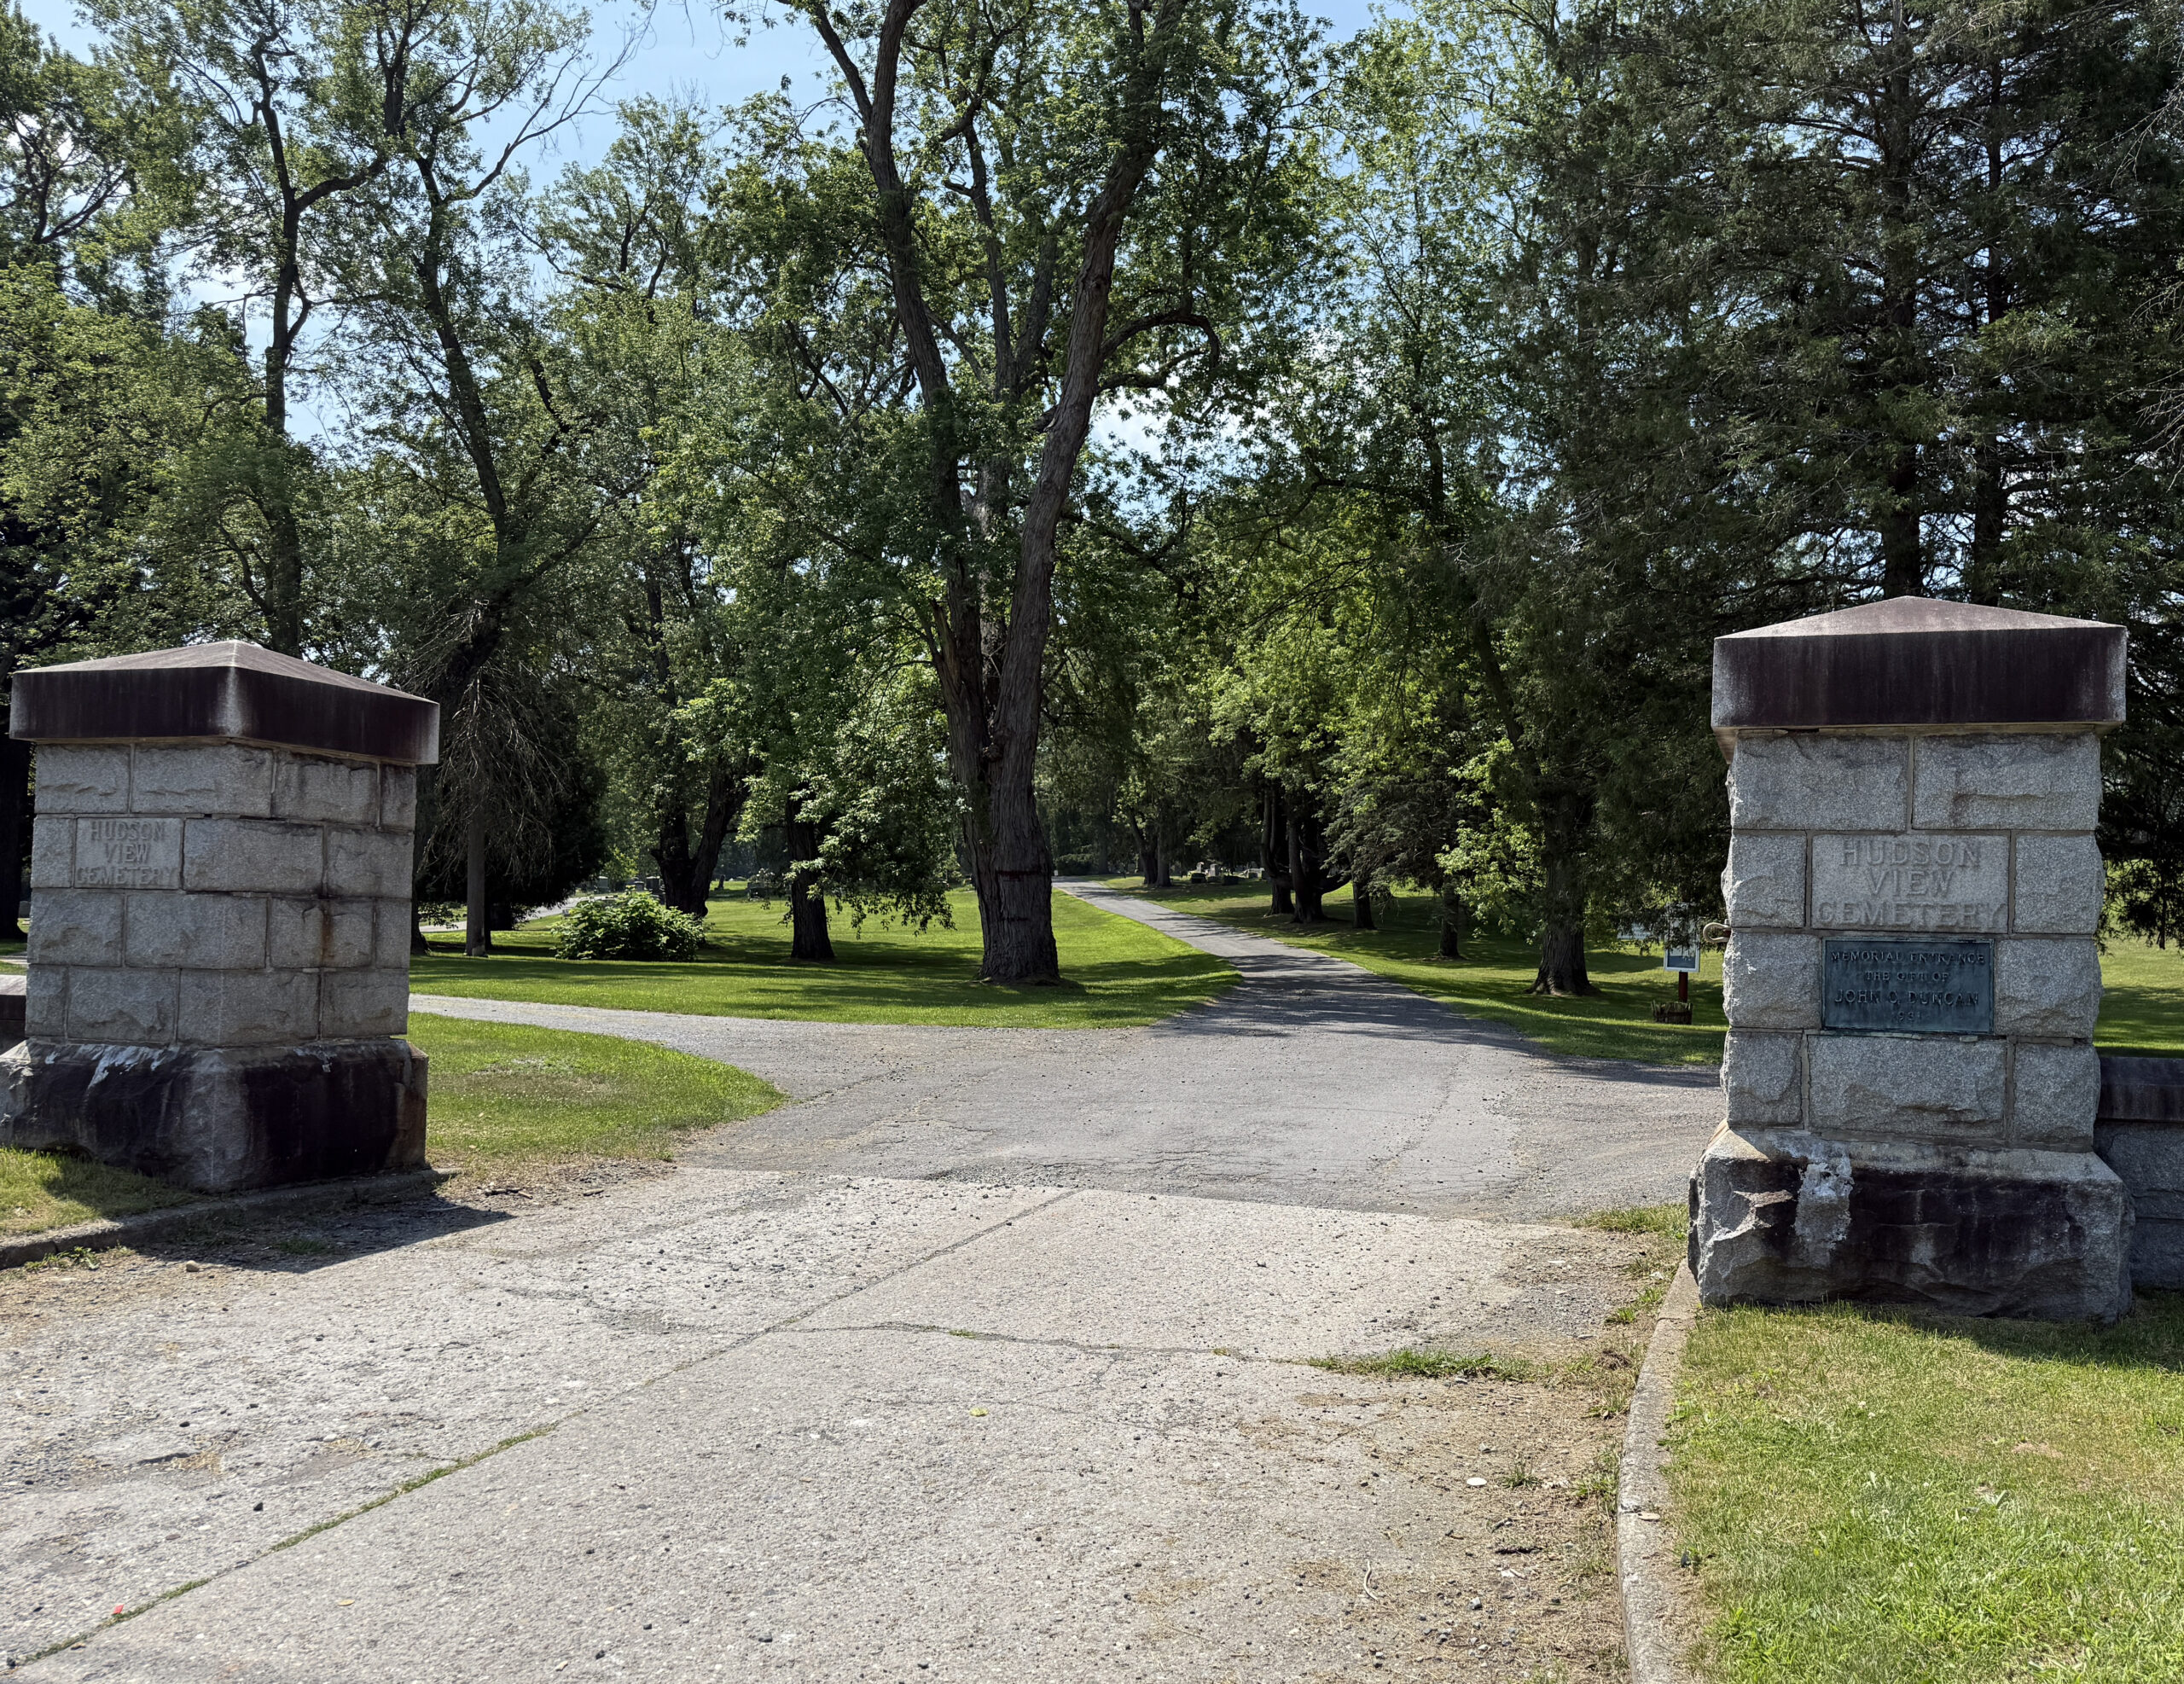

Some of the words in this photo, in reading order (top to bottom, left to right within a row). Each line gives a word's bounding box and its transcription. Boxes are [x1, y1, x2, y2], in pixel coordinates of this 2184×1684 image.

[90, 821, 166, 841] HUDSON
[103, 842, 151, 864] VIEW
[1839, 839, 1983, 868] HUDSON
[77, 866, 179, 886] CEMETERY
[1865, 870, 1955, 897] VIEW
[1818, 901, 2007, 928] CEMETERY
[1831, 950, 1902, 964] MEMORIAL
[1909, 952, 1986, 965] ENTRANCE
[1865, 971, 1890, 981] THE
[1896, 971, 1926, 982] GIFT
[1931, 971, 1949, 982] OF
[1834, 989, 1881, 1004] JOHN
[1908, 990, 1979, 1007] DUNCAN
